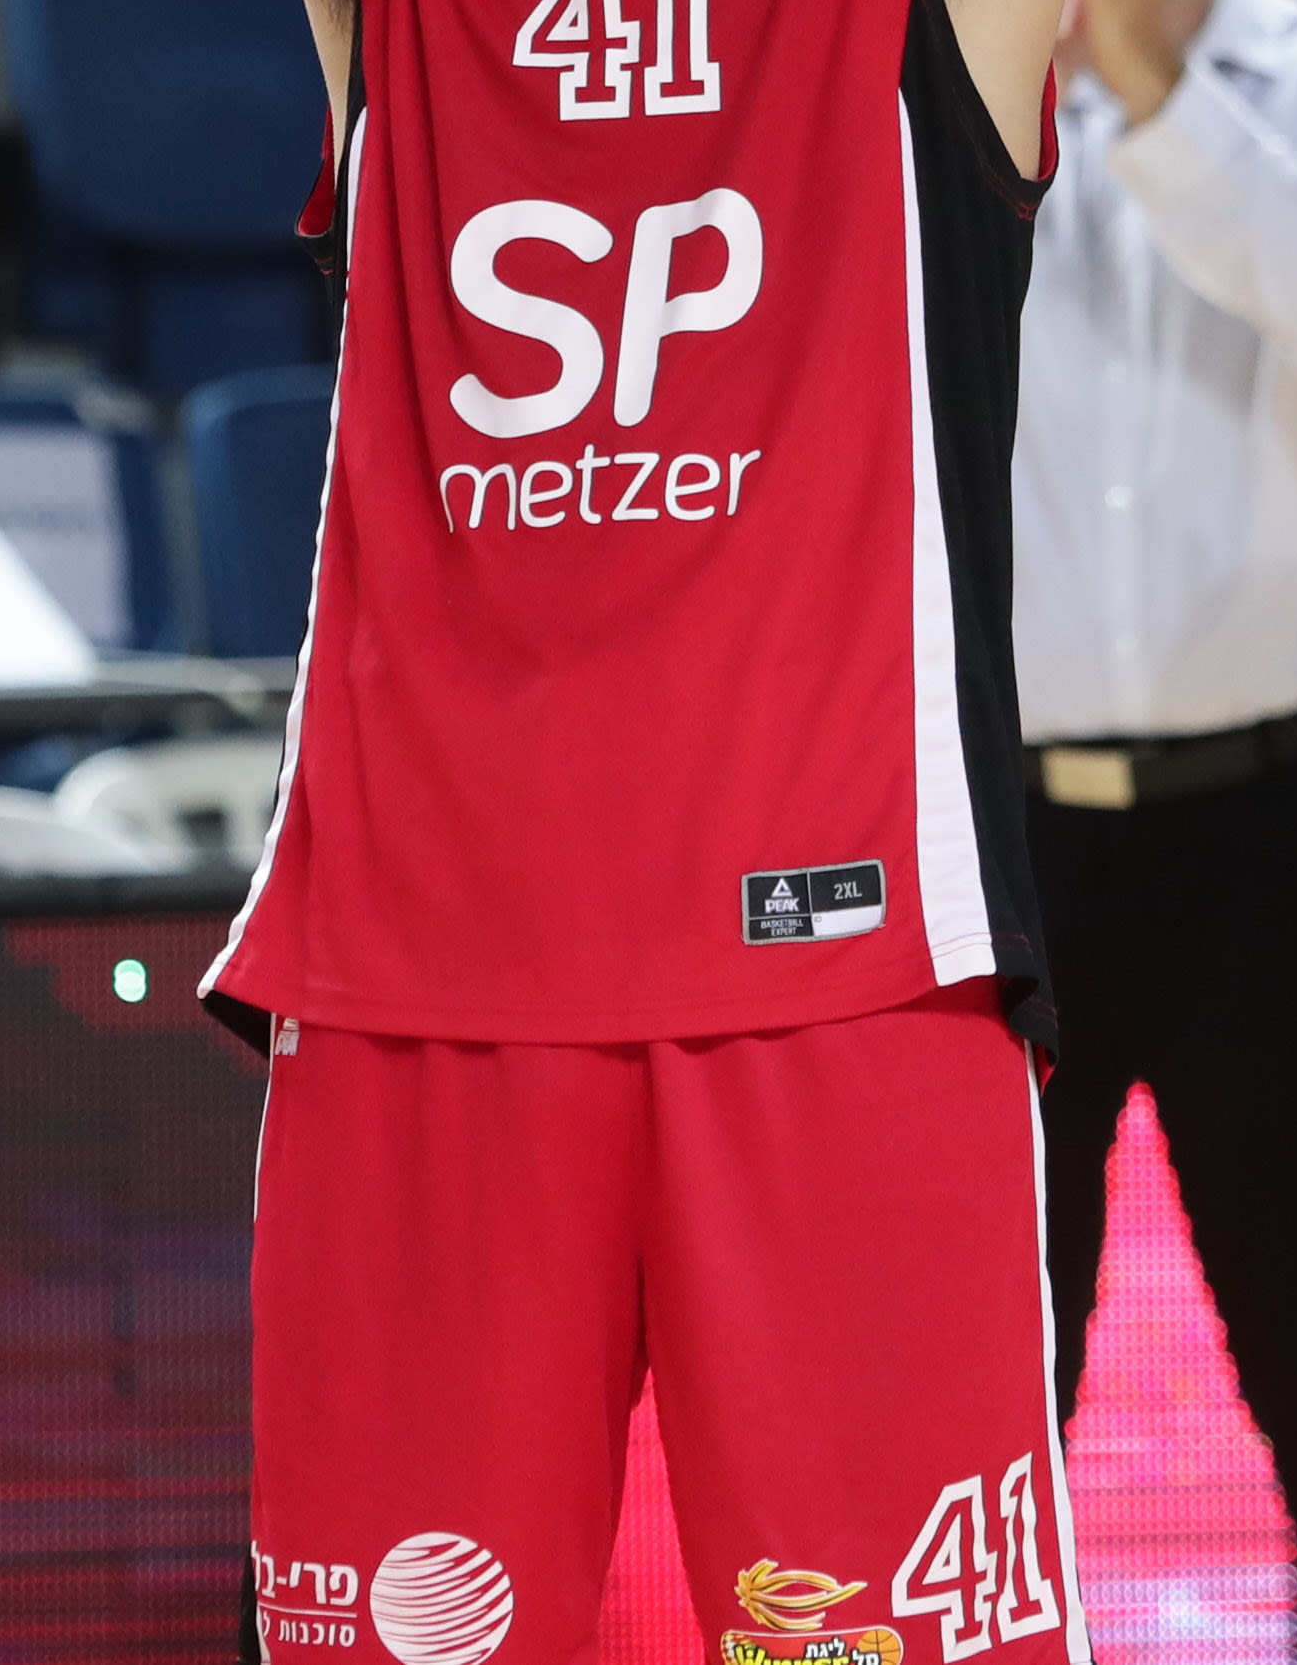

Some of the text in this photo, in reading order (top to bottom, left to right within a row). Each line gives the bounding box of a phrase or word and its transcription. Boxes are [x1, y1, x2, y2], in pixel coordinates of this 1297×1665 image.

[449, 187, 764, 438] SP
[439, 444, 762, 533] metzer
[834, 881, 862, 900] 2XL
[764, 897, 800, 914] PEAK
[891, 1451, 1062, 1664] 41
[278, 1619, 356, 1647] סוכנות
[805, 1637, 846, 1659] ליגת
